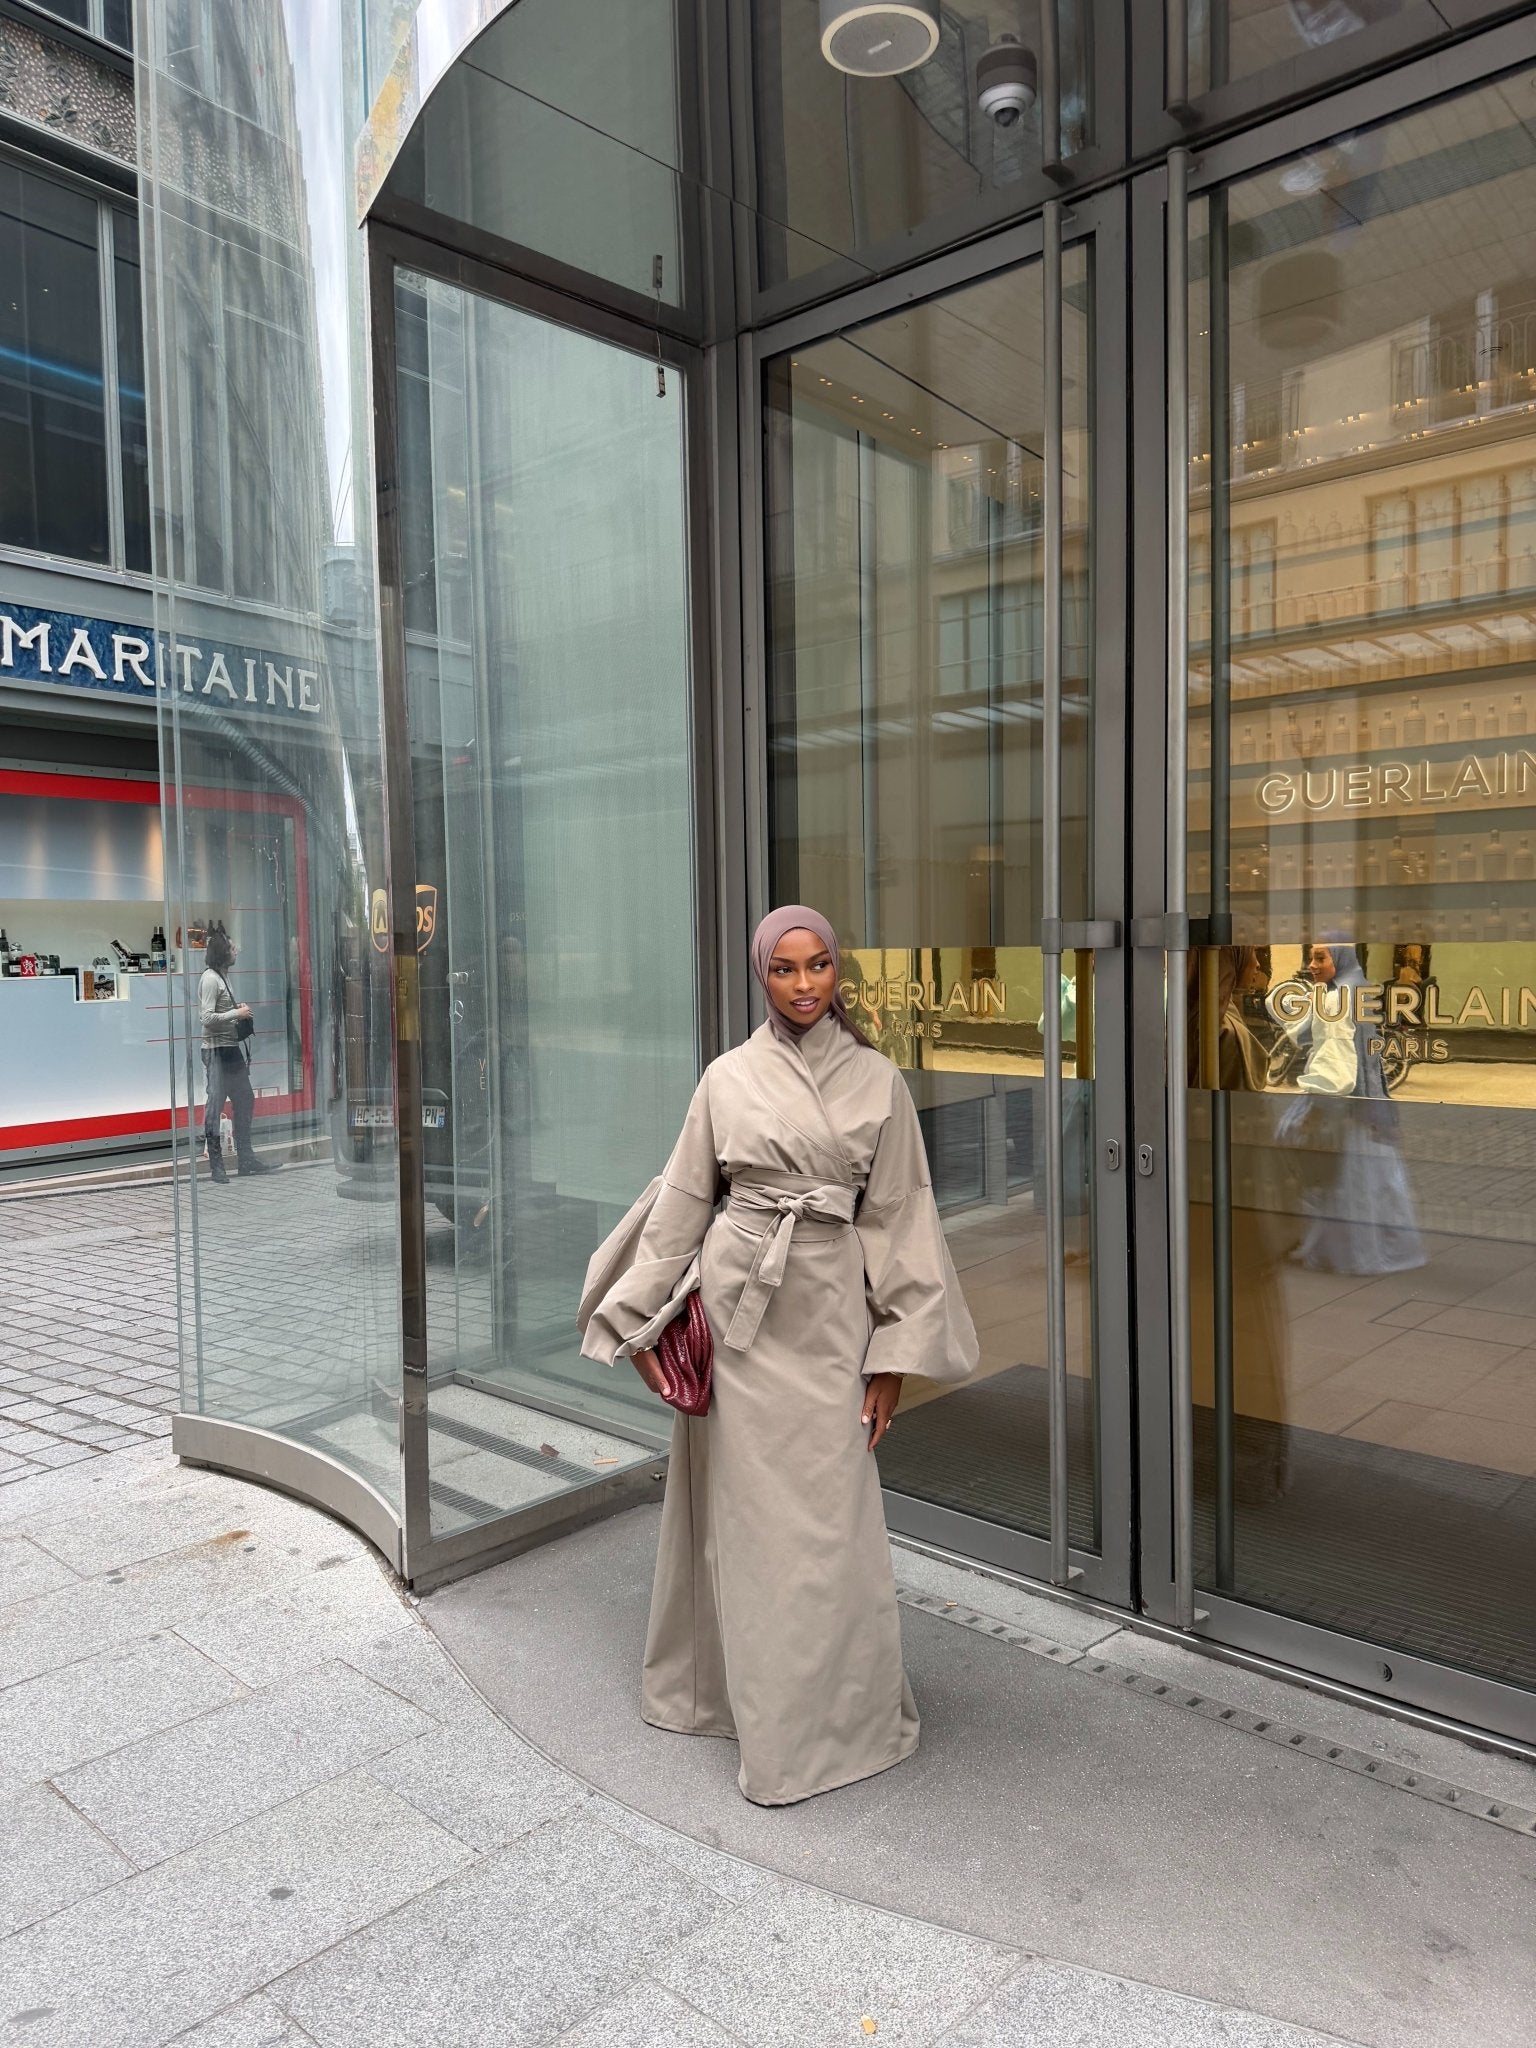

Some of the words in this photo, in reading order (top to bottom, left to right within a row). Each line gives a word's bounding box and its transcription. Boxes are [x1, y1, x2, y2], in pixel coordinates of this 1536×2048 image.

[0, 615, 321, 713] MARITAINE
[839, 978, 1007, 1013] GUERLAIN
[891, 1020, 943, 1038] PARIS
[1367, 1037, 1449, 1061] PARIS
